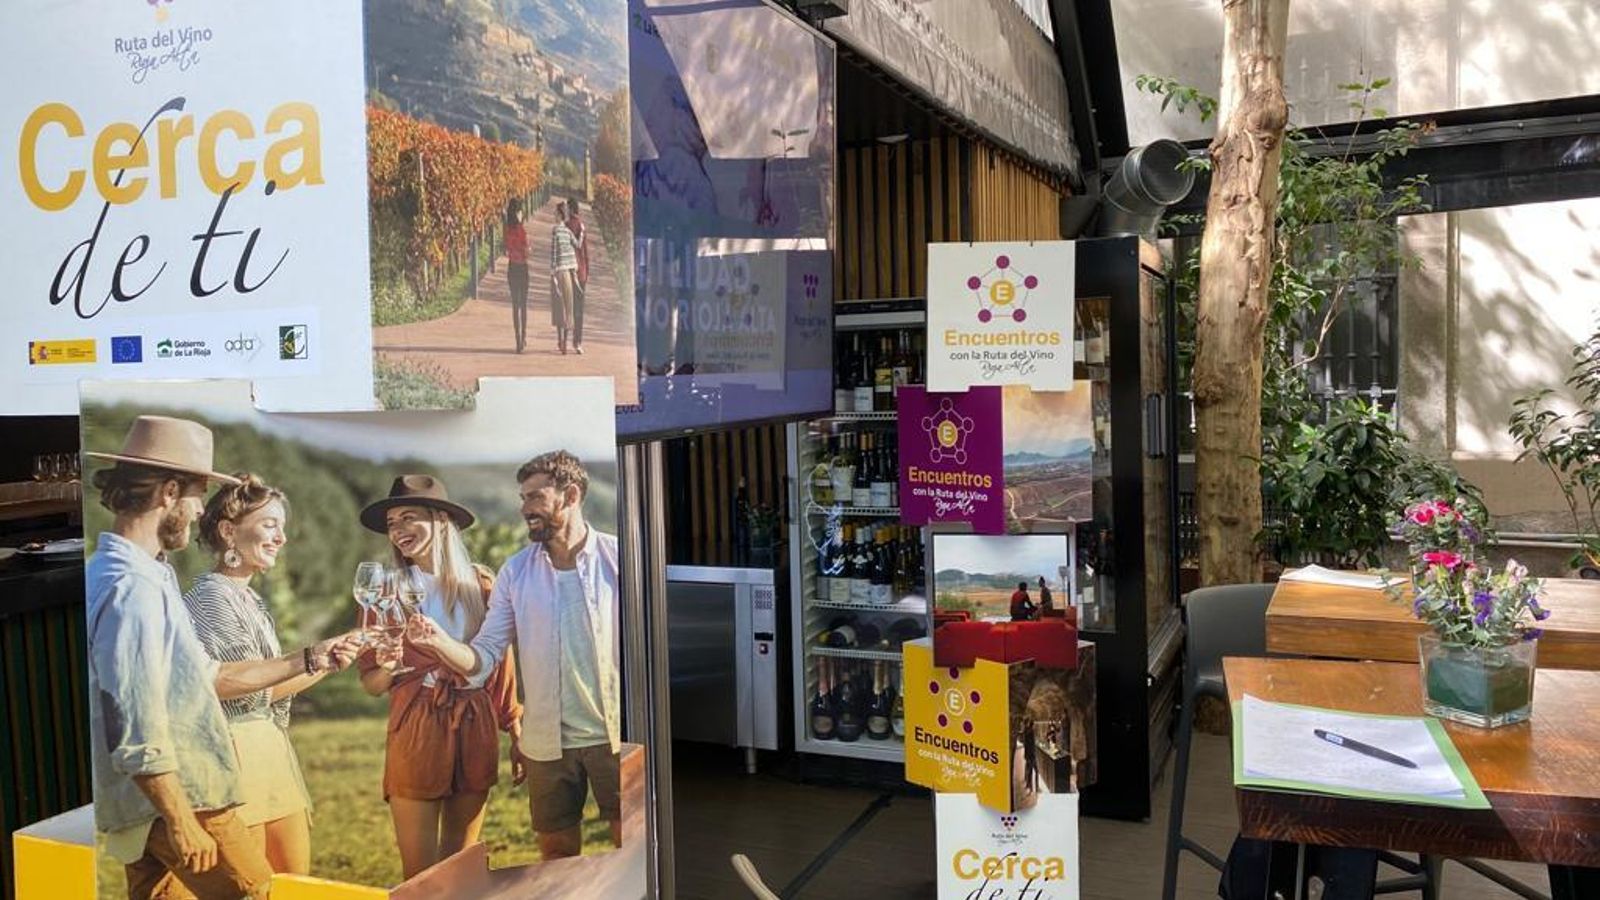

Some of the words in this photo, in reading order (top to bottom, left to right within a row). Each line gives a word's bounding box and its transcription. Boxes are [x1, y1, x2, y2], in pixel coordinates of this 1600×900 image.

[114, 36, 147, 53] Ruta
[151, 29, 174, 48] del
[178, 26, 212, 45] Vino
[18, 102, 326, 212] Cerca
[49, 97, 187, 319] de
[190, 179, 290, 298] ti
[995, 283, 1010, 301] E
[174, 339, 206, 348] Gobierno
[944, 329, 1061, 346] Encuentros
[174, 349, 184, 357] de
[184, 348, 192, 357] La
[193, 346, 212, 358] Rioja
[949, 351, 969, 360] con
[971, 350, 981, 360] la
[983, 350, 1007, 360] Ruta
[1010, 350, 1027, 360] del
[1029, 349, 1054, 360] Vino
[908, 466, 993, 488] Encuentros
[913, 487, 927, 496] con
[928, 486, 935, 497] la
[936, 488, 954, 498] Ruta
[955, 490, 968, 499] del
[969, 490, 988, 502] Vino
[914, 726, 1000, 765] Encuentros
[952, 848, 1065, 880] Cerca
